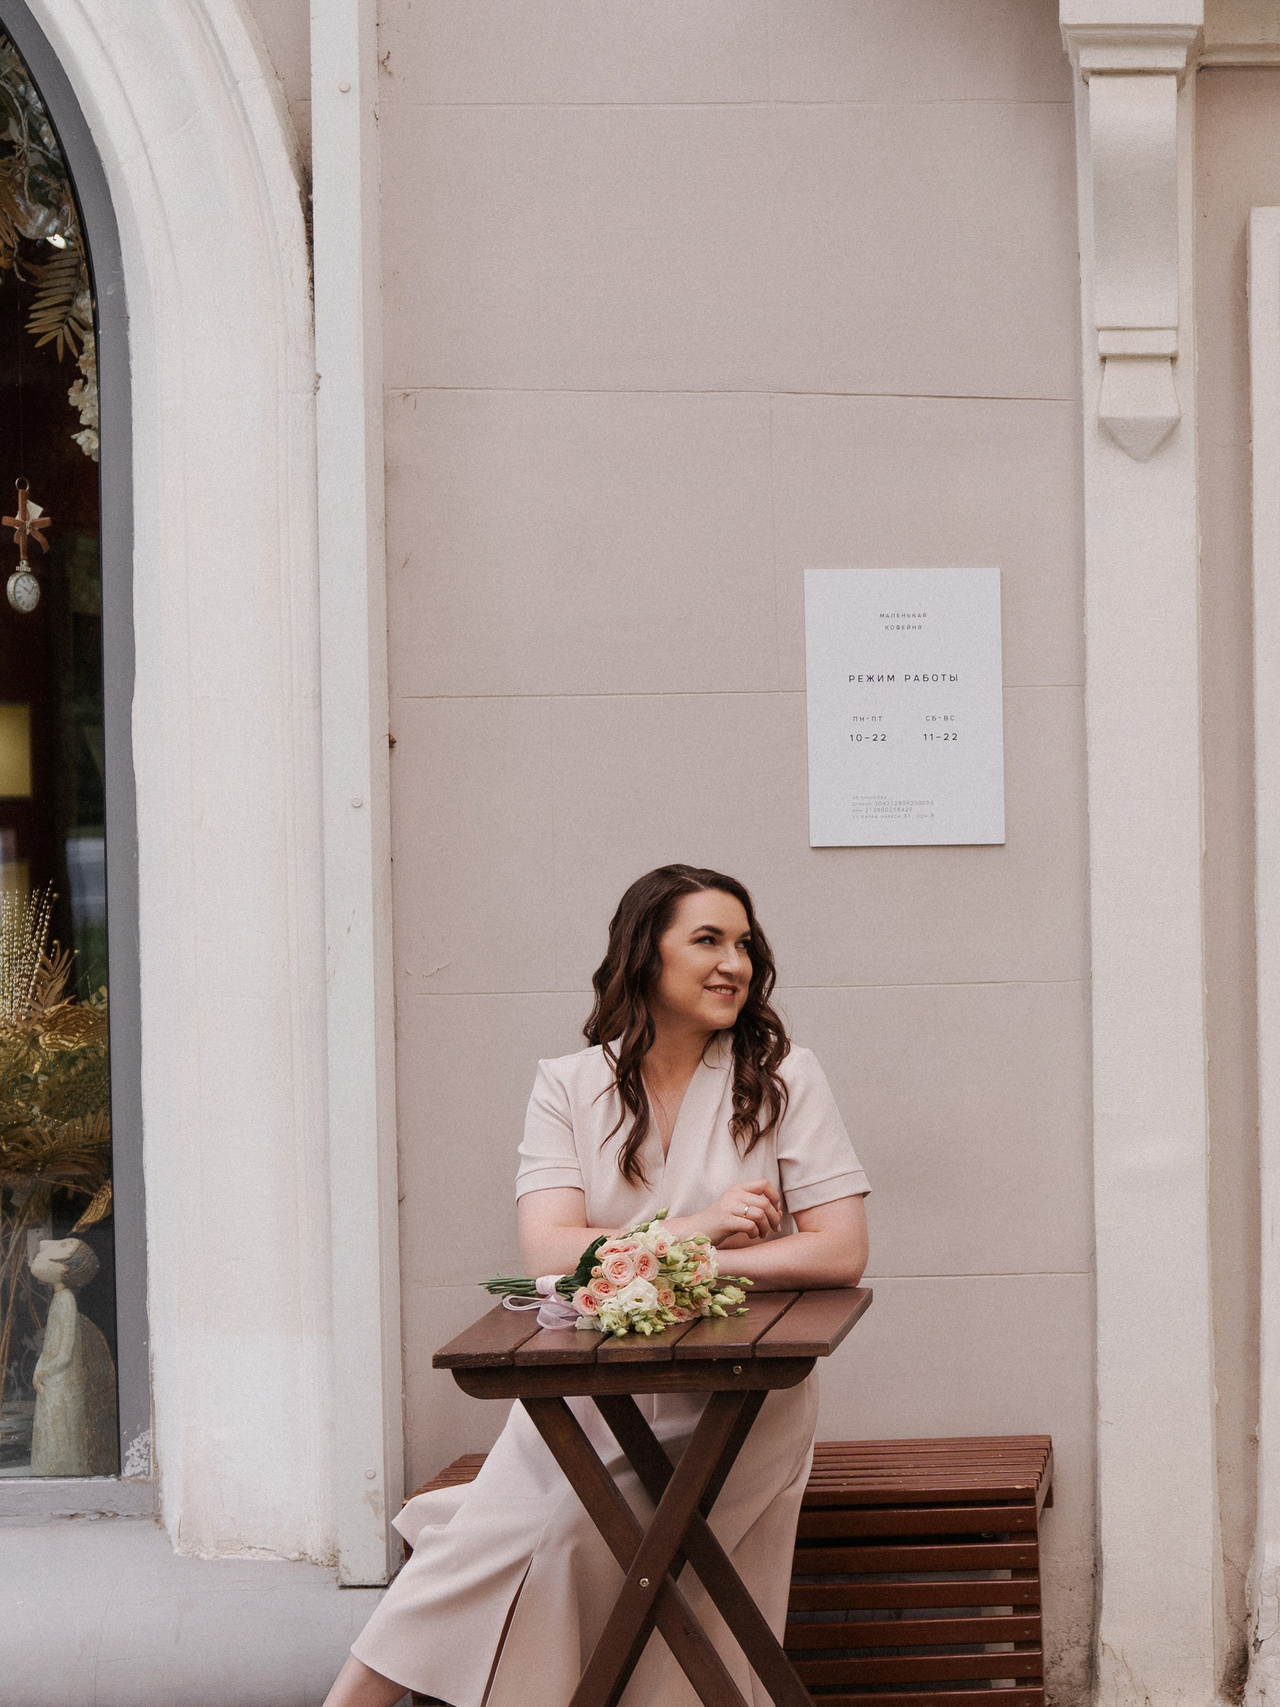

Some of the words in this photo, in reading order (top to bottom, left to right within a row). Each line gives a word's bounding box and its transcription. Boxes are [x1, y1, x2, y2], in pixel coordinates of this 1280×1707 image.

[848, 674, 896, 683] РЕЖИМ
[904, 673, 959, 683] РАБОТЫ
[925, 714, 955, 722] СБ-ВС
